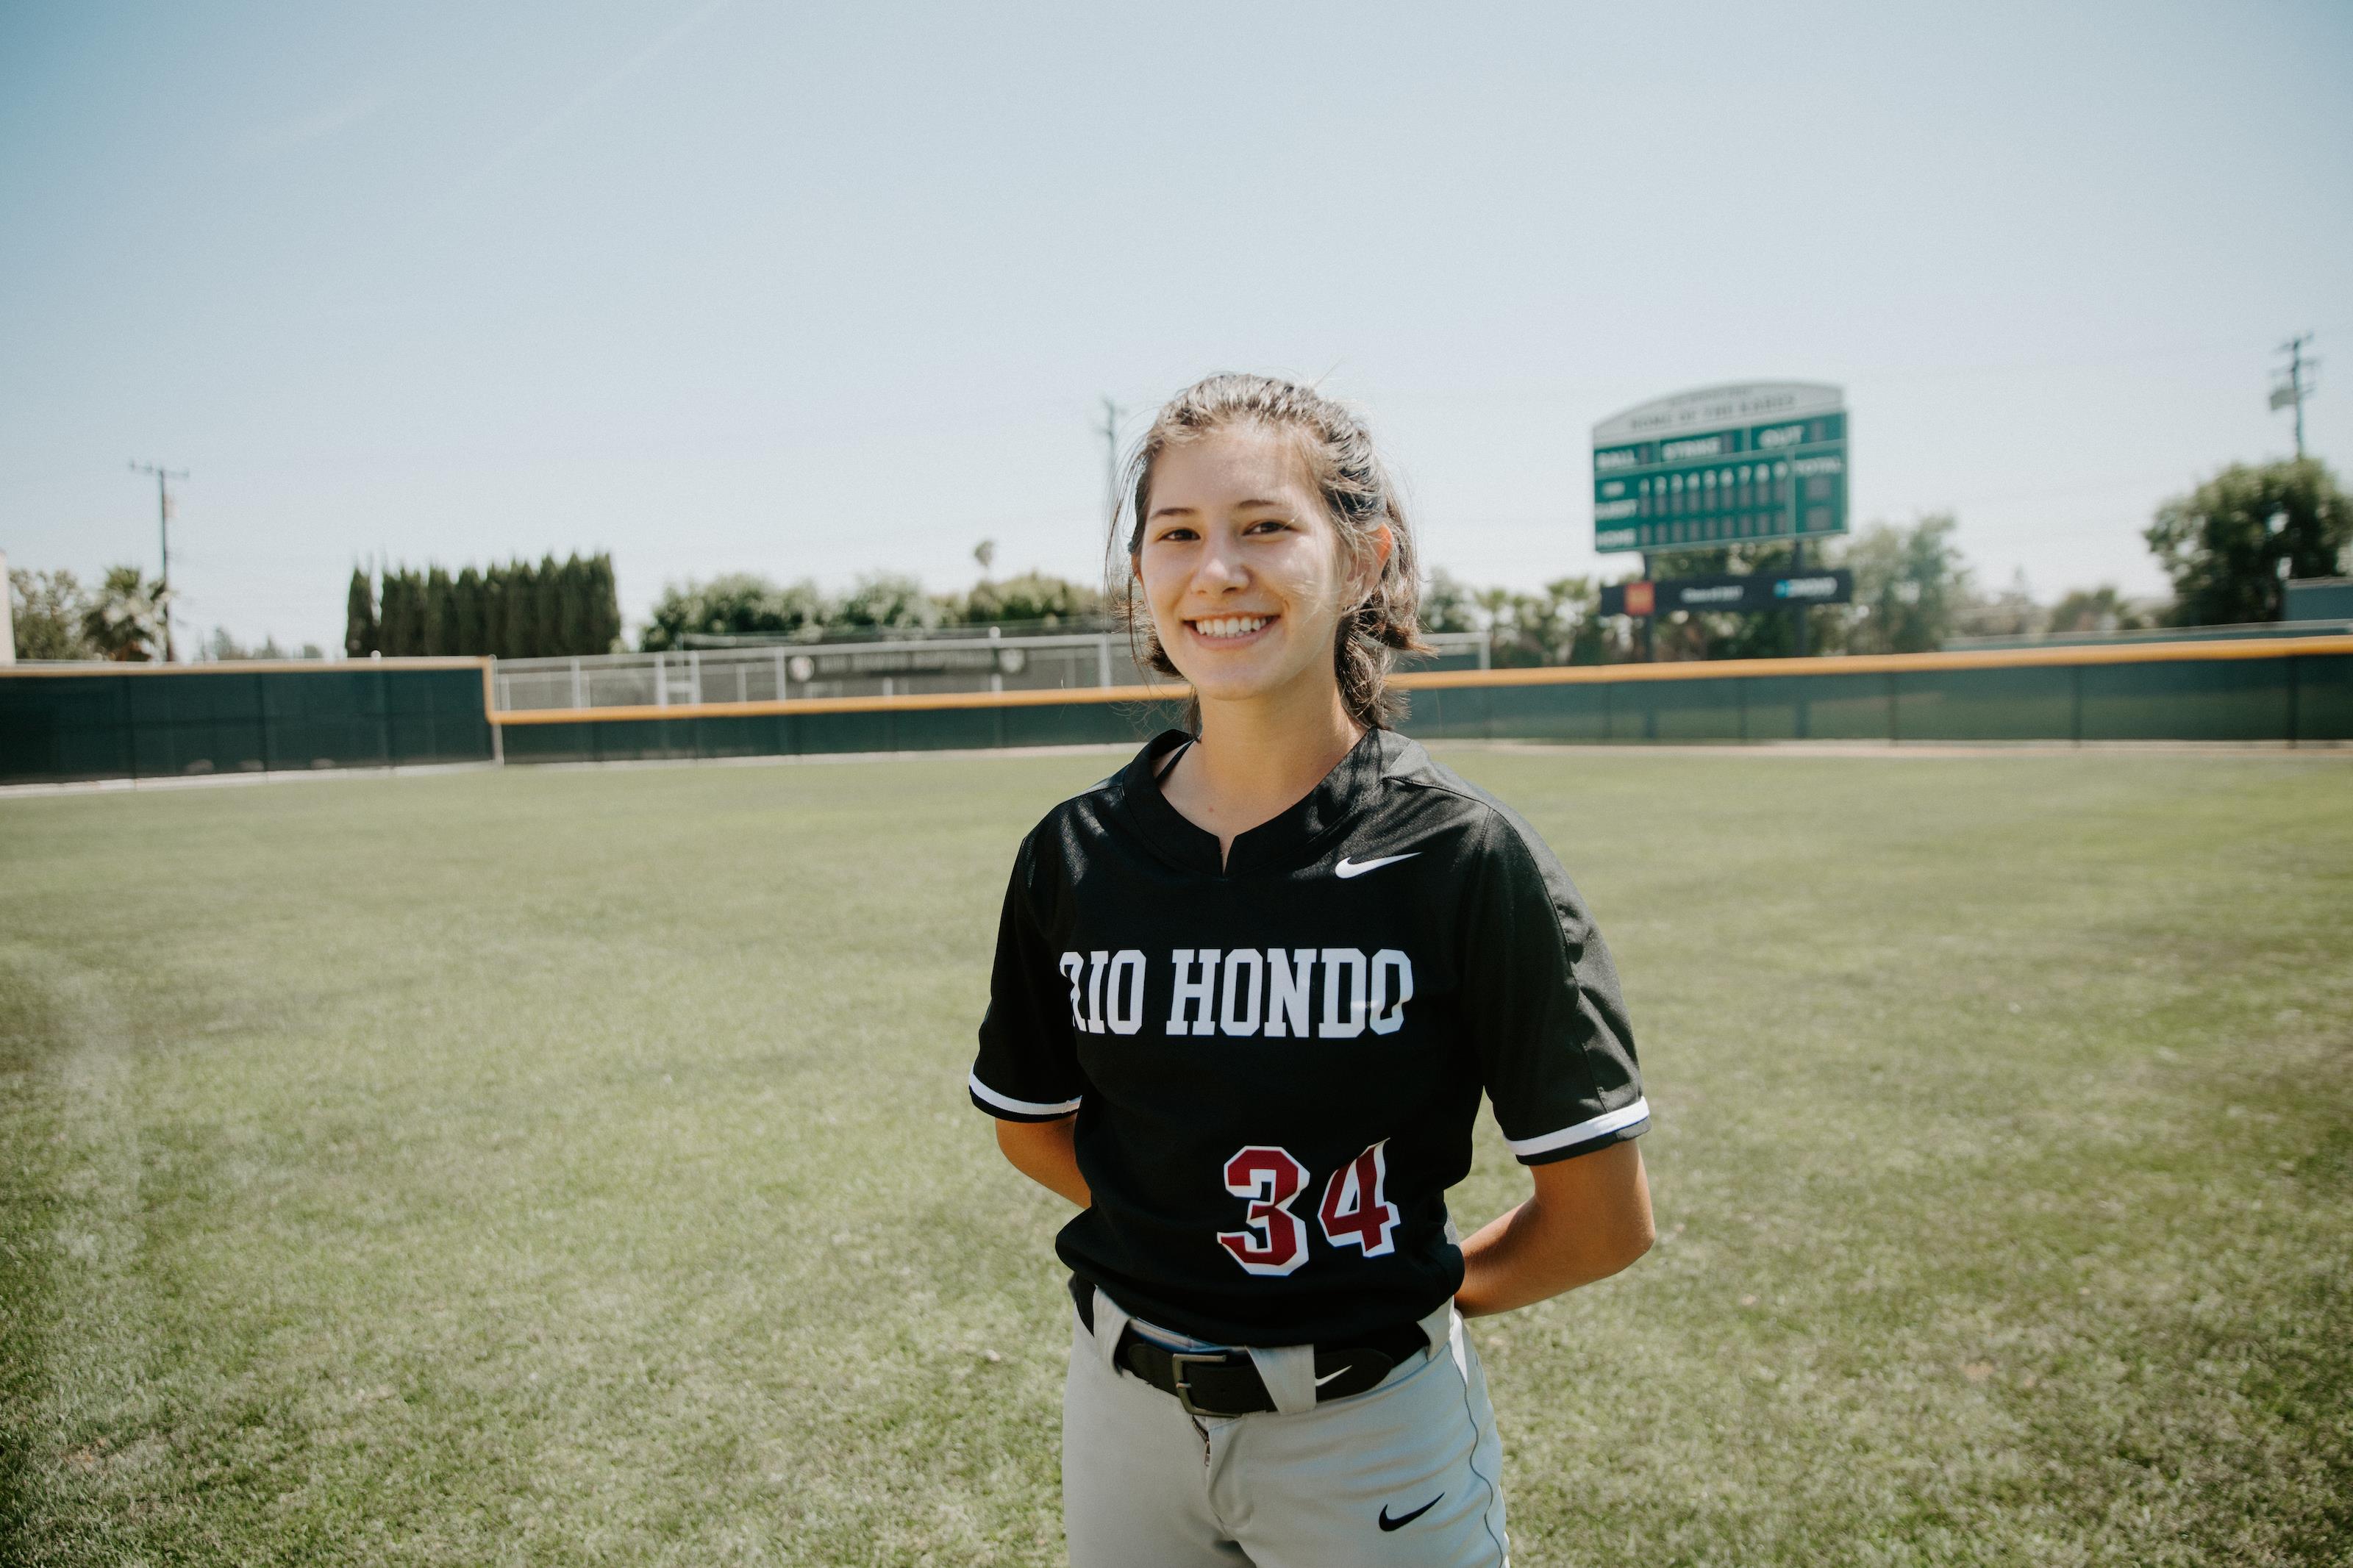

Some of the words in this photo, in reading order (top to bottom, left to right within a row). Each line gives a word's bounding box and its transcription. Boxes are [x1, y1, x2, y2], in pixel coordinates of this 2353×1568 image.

[1759, 425, 1804, 448] OUT
[1596, 449, 1635, 470] BALL
[1662, 437, 1721, 461] STRIKE
[1166, 948, 1413, 1038] HONDO
[1217, 1137, 1401, 1276] 34
